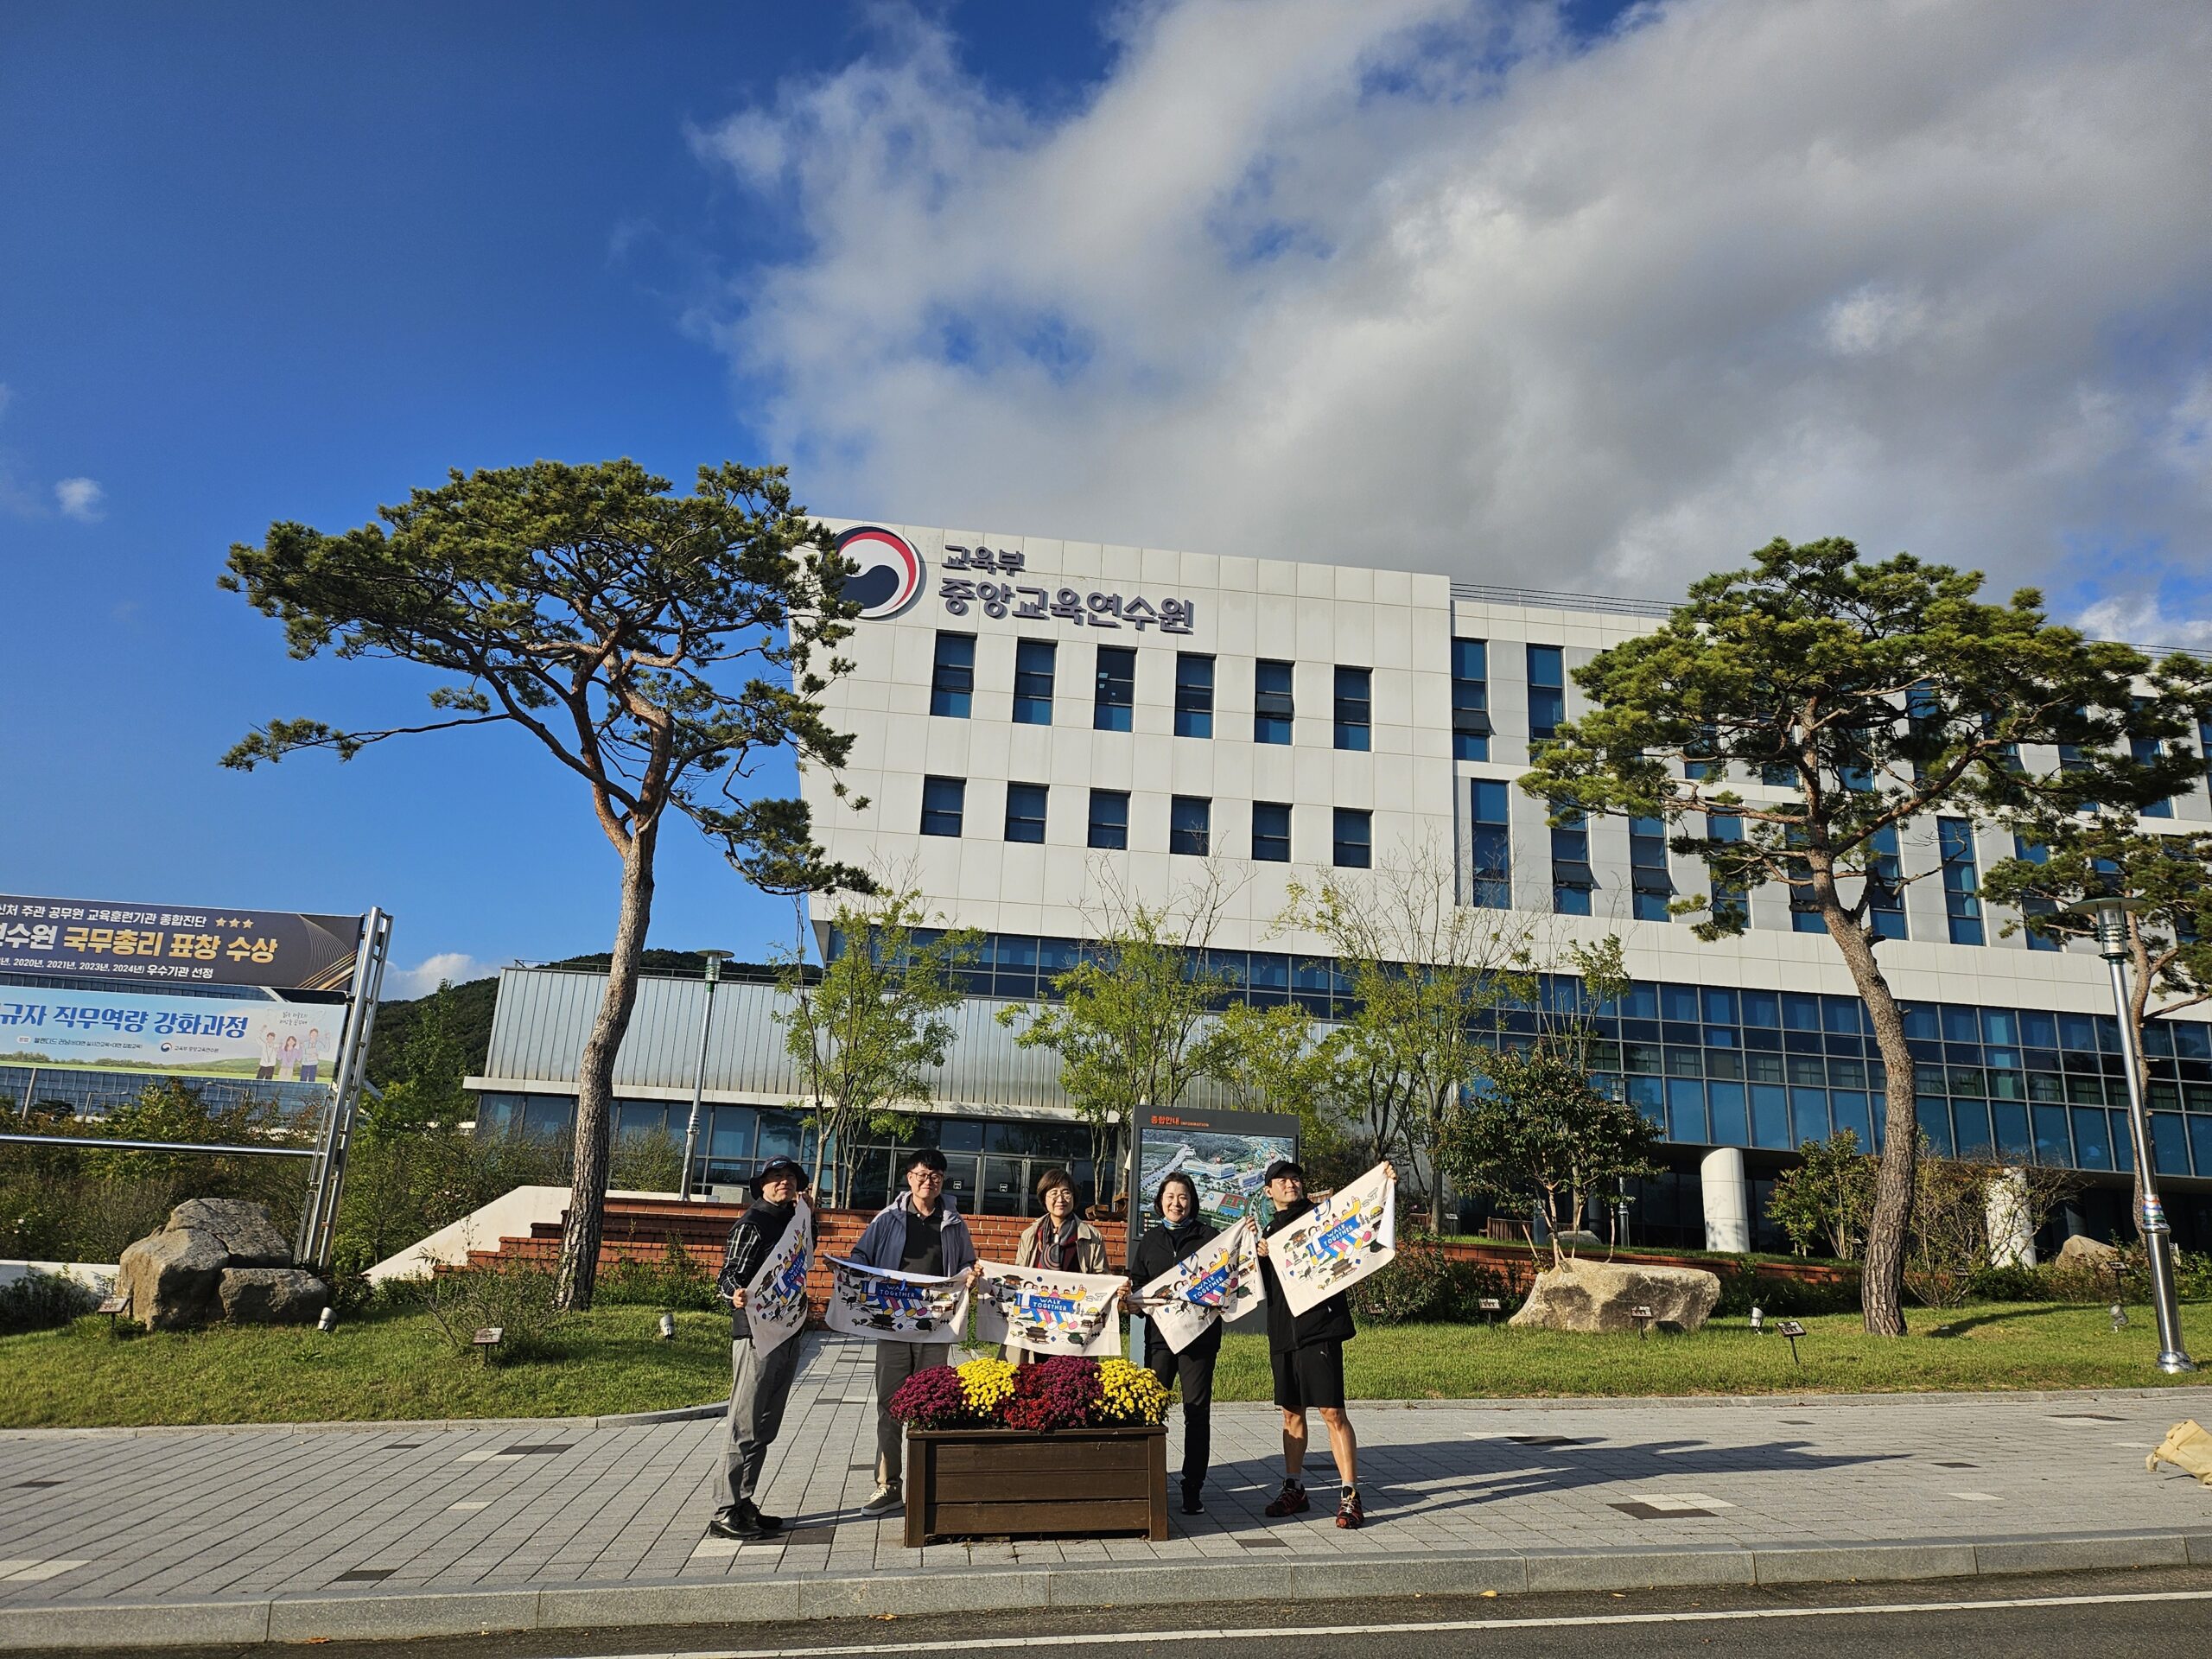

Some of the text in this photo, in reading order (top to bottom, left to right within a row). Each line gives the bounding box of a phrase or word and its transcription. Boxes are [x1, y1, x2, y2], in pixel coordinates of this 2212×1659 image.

[942, 544, 1023, 576] 교육부
[939, 577, 1192, 634] 중앙교육연수원
[22, 905, 46, 918] 주관
[48, 906, 85, 920] 공무원
[86, 908, 157, 925] 교육훈련기관
[160, 913, 207, 928] 종합진단
[63, 926, 164, 957] 국무총리
[168, 933, 221, 960] 표창
[226, 937, 278, 963] 수상
[147, 964, 189, 977] 우수기관
[191, 967, 214, 979] 선정
[0, 1003, 249, 1039] 규자 직무역량 강화과정
[1151, 1115, 1180, 1126] 종합안내
[1324, 1224, 1354, 1246] TOGETHER
[1326, 1224, 1345, 1237] WALK
[880, 1289, 915, 1298] TOGETHER
[1192, 1276, 1224, 1300] TOGETHER
[1195, 1275, 1215, 1291] WALK
[1033, 1302, 1067, 1312] TOGETHER
